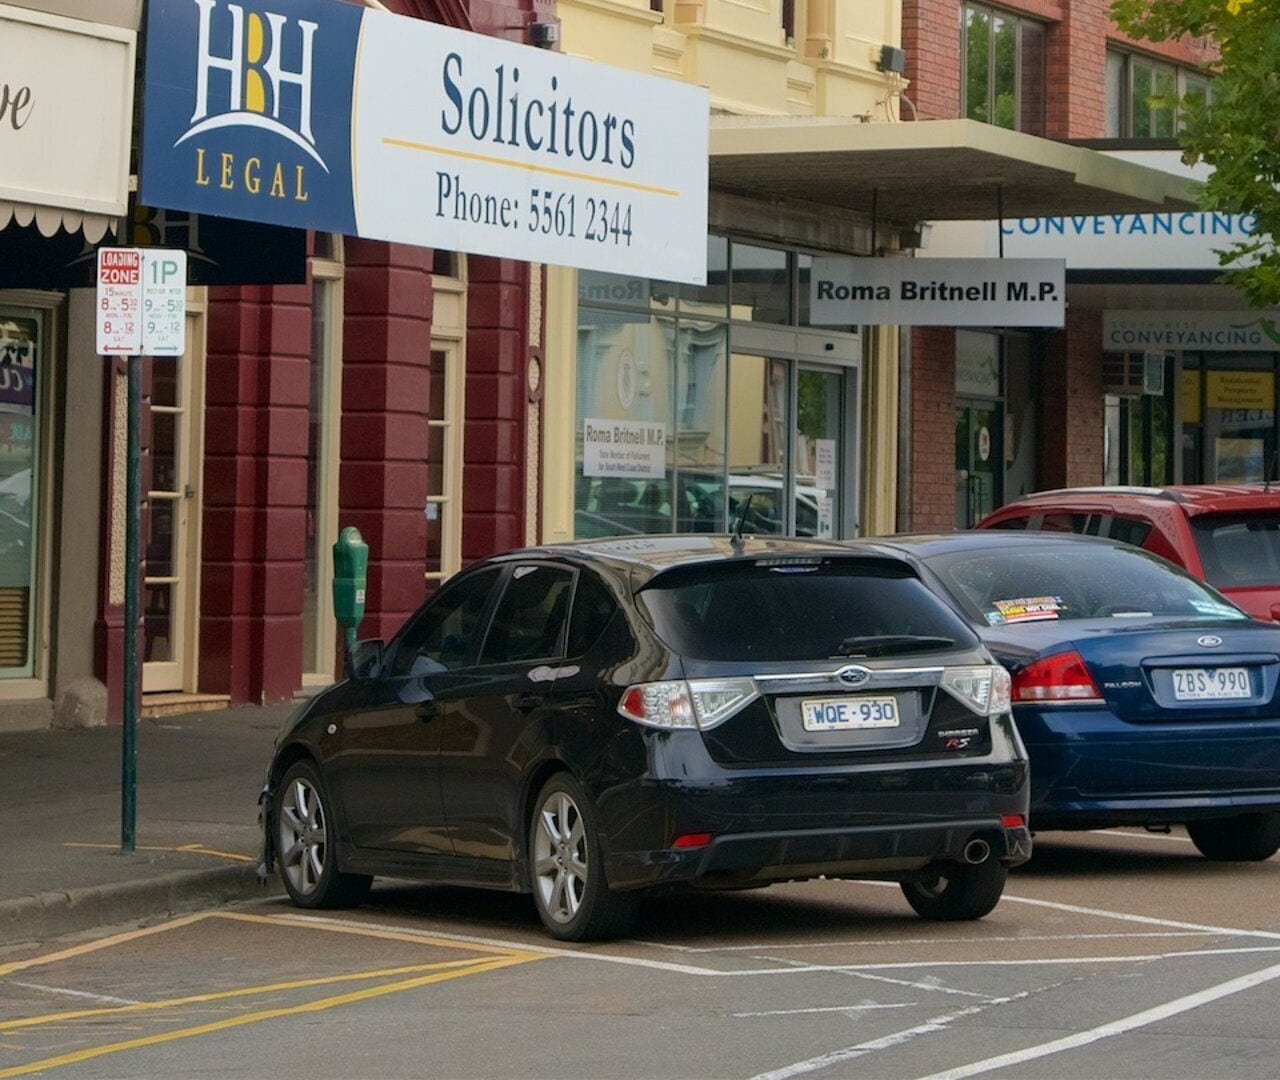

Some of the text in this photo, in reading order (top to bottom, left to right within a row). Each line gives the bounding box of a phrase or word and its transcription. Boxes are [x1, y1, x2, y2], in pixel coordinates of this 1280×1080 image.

[441, 52, 635, 169] Solicitors
[196, 148, 308, 200] LEGAL
[435, 171, 633, 246] Phone: 5561 2344
[102, 251, 138, 266] LOADING
[101, 270, 139, 282] ZONE
[151, 260, 178, 284] 1P
[817, 280, 1058, 301] Roma Britnell M.P.
[1110, 330, 1262, 345] CONVEYANCING
[586, 424, 664, 446] Roma Britnell M.P.
[1175, 671, 1247, 693] ZBS 990
